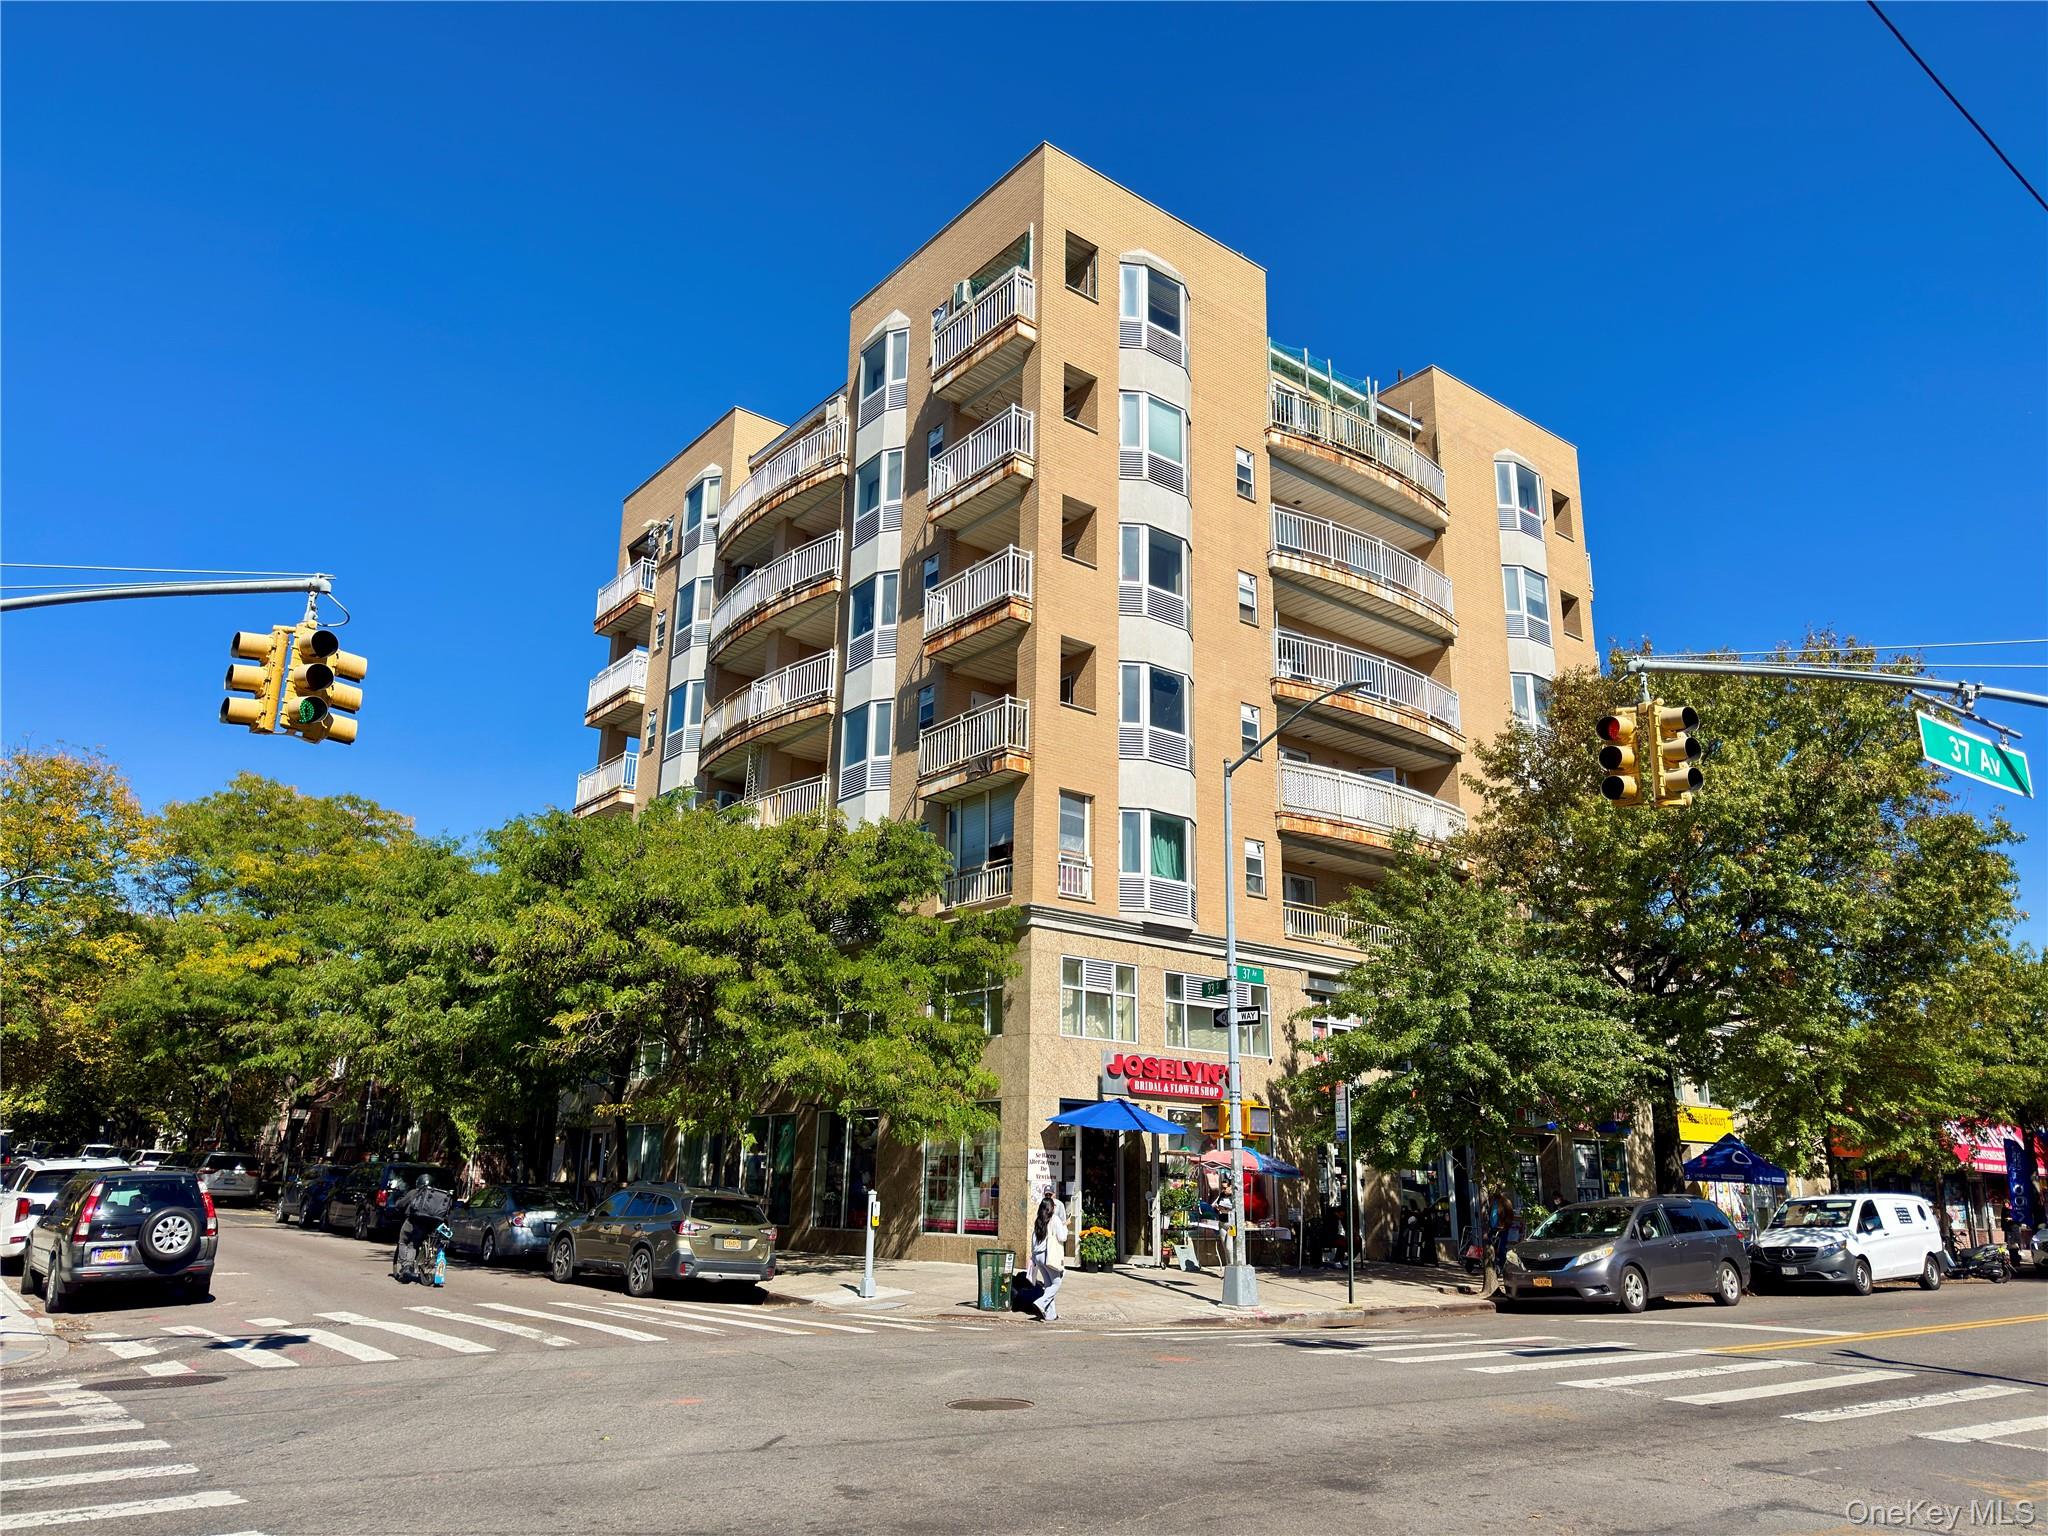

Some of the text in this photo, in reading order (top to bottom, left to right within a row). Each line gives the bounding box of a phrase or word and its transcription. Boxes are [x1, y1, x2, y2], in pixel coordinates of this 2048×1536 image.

[1948, 735, 2000, 777] 37 Av
[1242, 968, 1251, 980] 37
[1207, 983, 1215, 995] 93
[1240, 1011, 1256, 1020] WAY
[1107, 1054, 1231, 1085] JOSELYN'
[1134, 1080, 1220, 1098] BRIDAL & FLOWER SHOP
[2013, 1183, 2028, 1222] vigo
